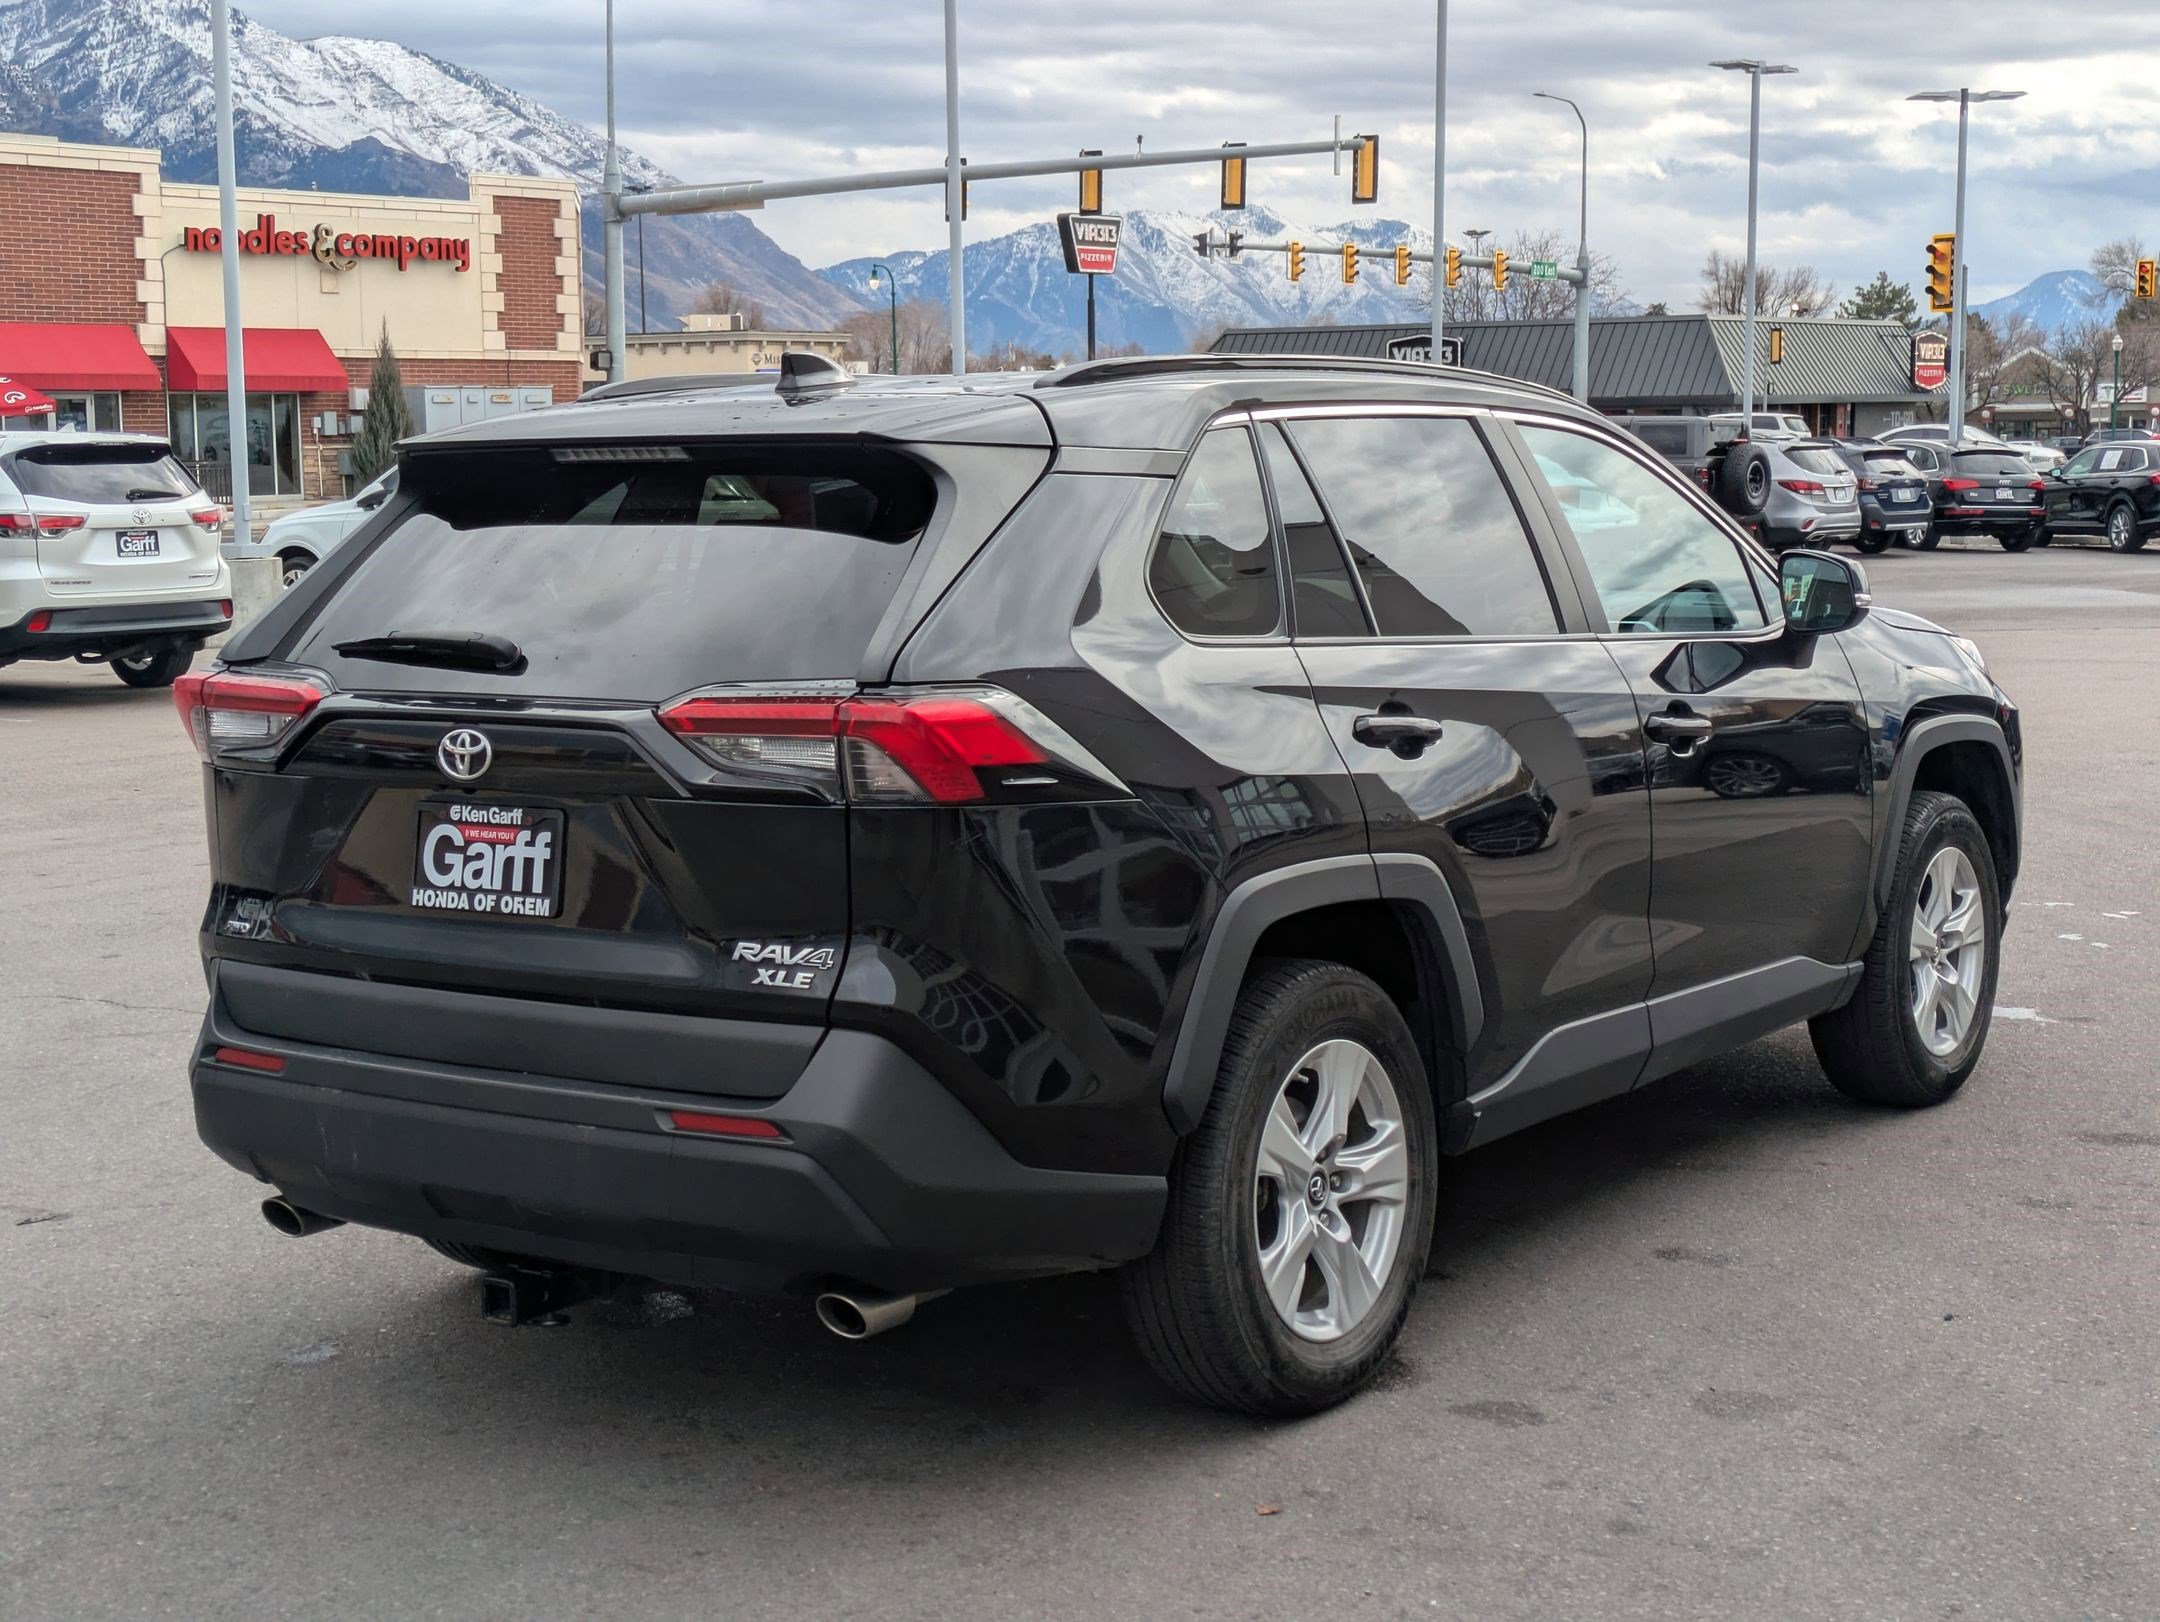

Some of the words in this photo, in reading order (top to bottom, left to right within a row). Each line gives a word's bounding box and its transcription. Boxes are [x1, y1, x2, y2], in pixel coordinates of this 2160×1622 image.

[334, 232, 470, 272] company
[1080, 253, 1113, 262] PIZZERIA
[1391, 345, 1453, 364] VIA33
[120, 535, 156, 552] Garff
[462, 805, 487, 823] Ken
[488, 807, 523, 825] Garff
[470, 829, 480, 838] WE
[480, 830, 497, 839] HEAR
[498, 831, 510, 840] YOU
[423, 823, 552, 894] Garff
[411, 888, 469, 911] HONDA
[473, 893, 497, 912] OF
[500, 896, 550, 917] OREM
[731, 942, 835, 970] RAV4
[751, 968, 815, 989] XLE
